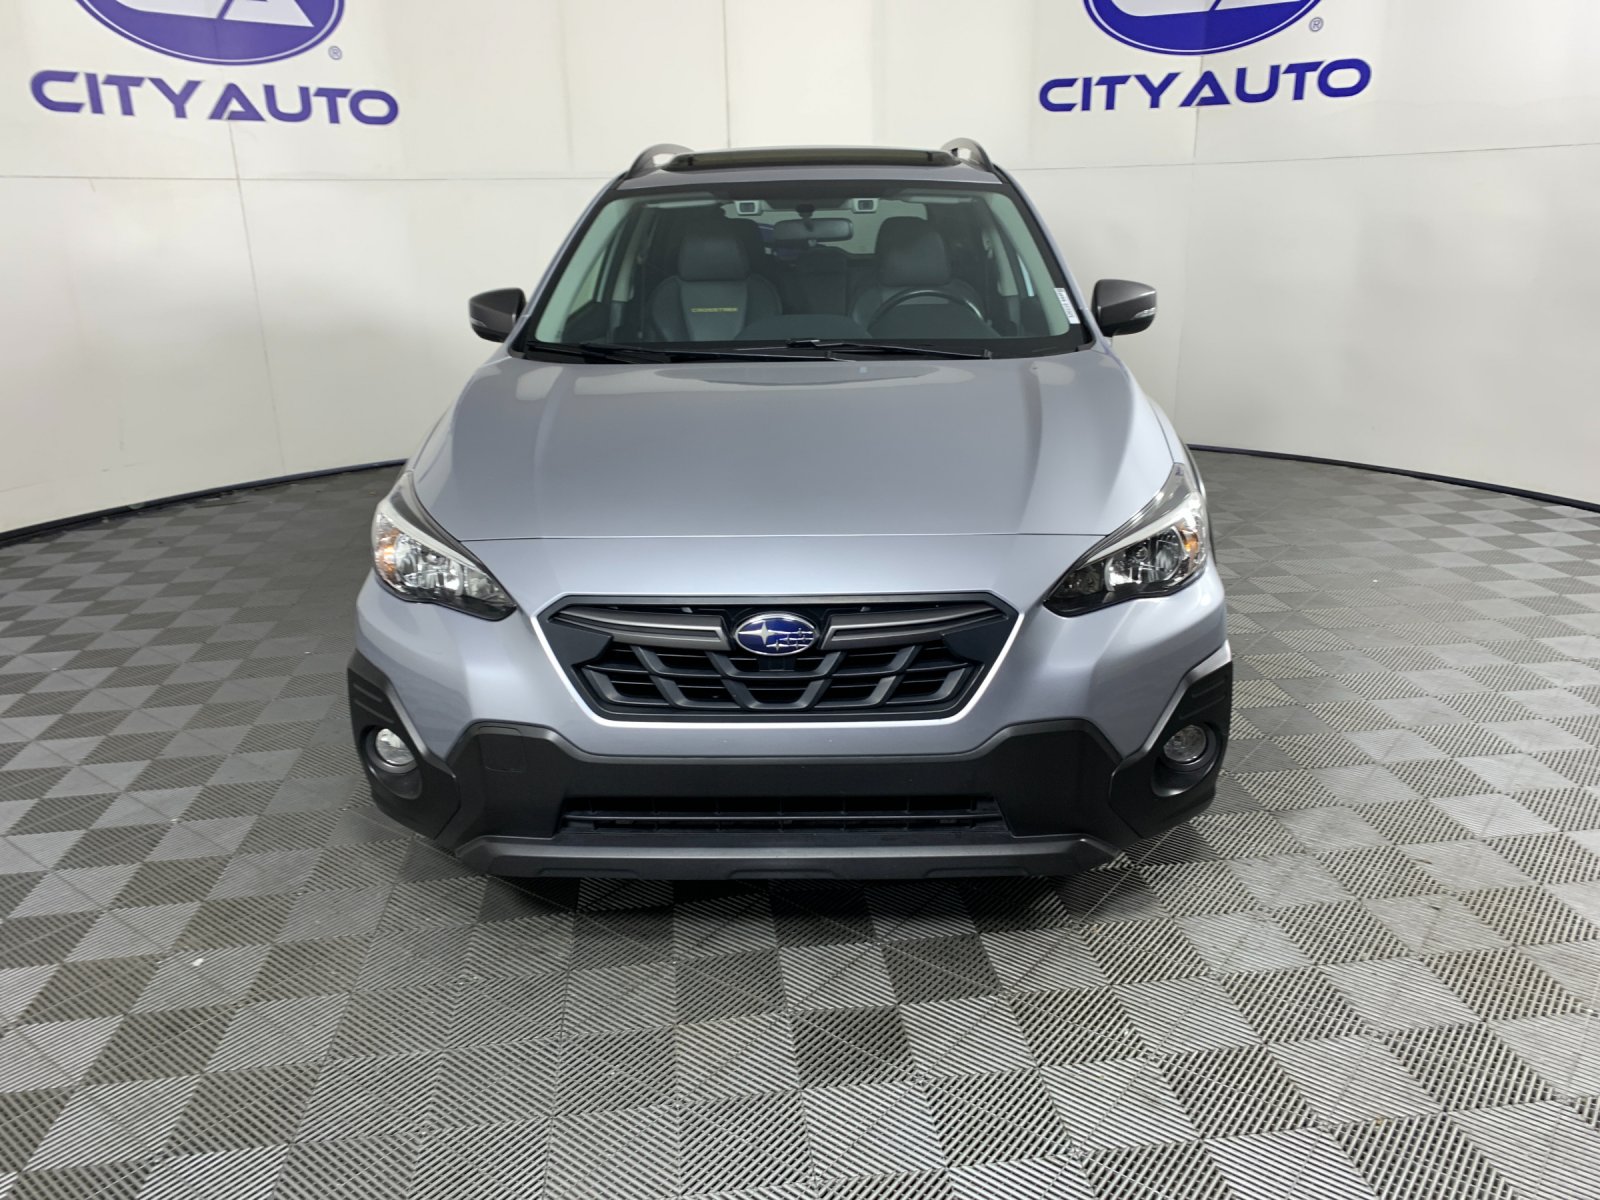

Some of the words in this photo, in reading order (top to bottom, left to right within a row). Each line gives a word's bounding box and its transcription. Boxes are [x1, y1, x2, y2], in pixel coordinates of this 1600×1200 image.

[31, 70, 203, 118] CITY
[208, 83, 399, 125] AUTO
[1039, 72, 1181, 112] CITY
[1178, 58, 1372, 108] AUTO
